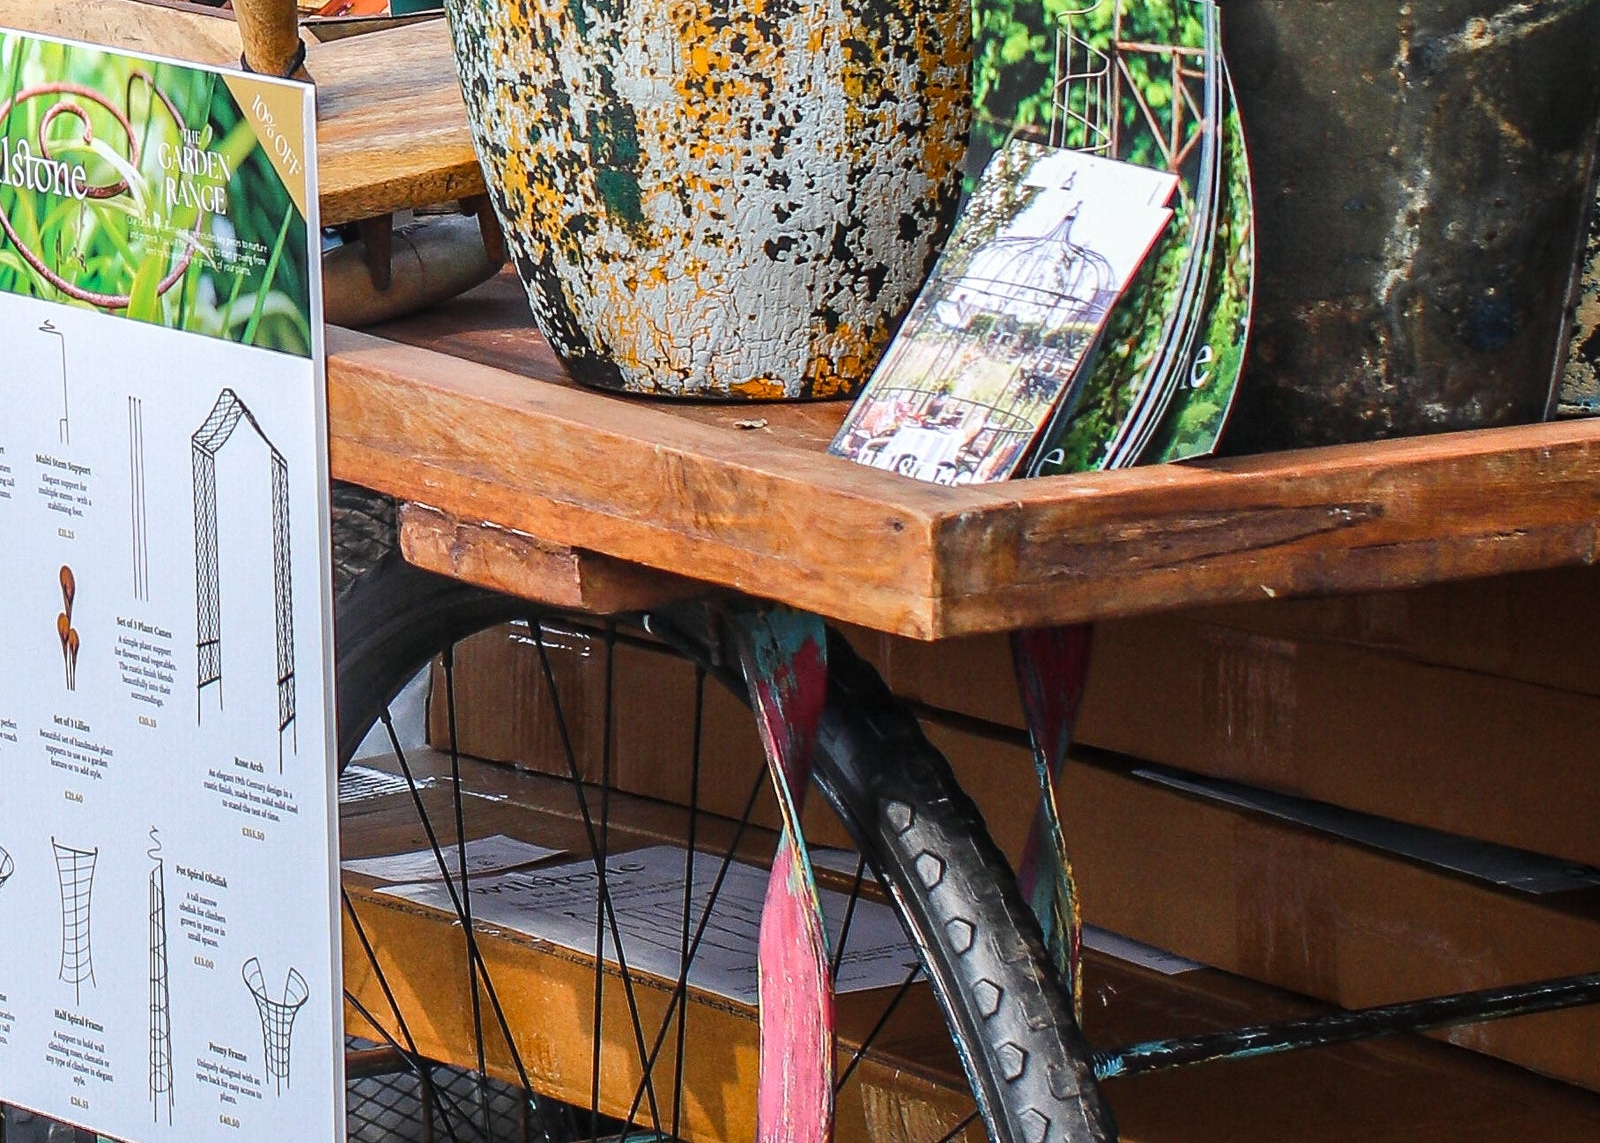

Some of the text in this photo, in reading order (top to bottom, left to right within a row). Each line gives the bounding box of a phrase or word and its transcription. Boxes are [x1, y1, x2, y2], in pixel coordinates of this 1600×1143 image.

[182, 127, 200, 145] THE
[252, 95, 302, 177] 10% OFF
[158, 143, 232, 182] GARDEN
[166, 177, 227, 215] RANGE
[36, 453, 90, 478] Multi Stem Support
[116, 616, 125, 627] Set
[126, 619, 132, 628] of
[137, 621, 152, 634] Plant
[154, 626, 172, 639] Canes
[53, 713, 62, 725] Set
[63, 715, 69, 727] of
[234, 757, 264, 773] Rose Arch
[216, 769, 233, 784] elegant
[234, 775, 245, 786] 19th
[246, 778, 265, 793] Century
[266, 783, 282, 798] design
[228, 799, 241, 811] stand
[242, 803, 250, 814] the
[251, 807, 260, 817] test
[176, 864, 227, 888] Pot Spiral Obelisk
[190, 891, 198, 902] tall
[199, 896, 217, 907] narrow
[179, 901, 196, 914] obelisk
[204, 908, 225, 923] climbers
[187, 930, 219, 949] small spaces.
[54, 1008, 103, 1033] Half Spiral Frame
[228, 1048, 246, 1062] Frame
